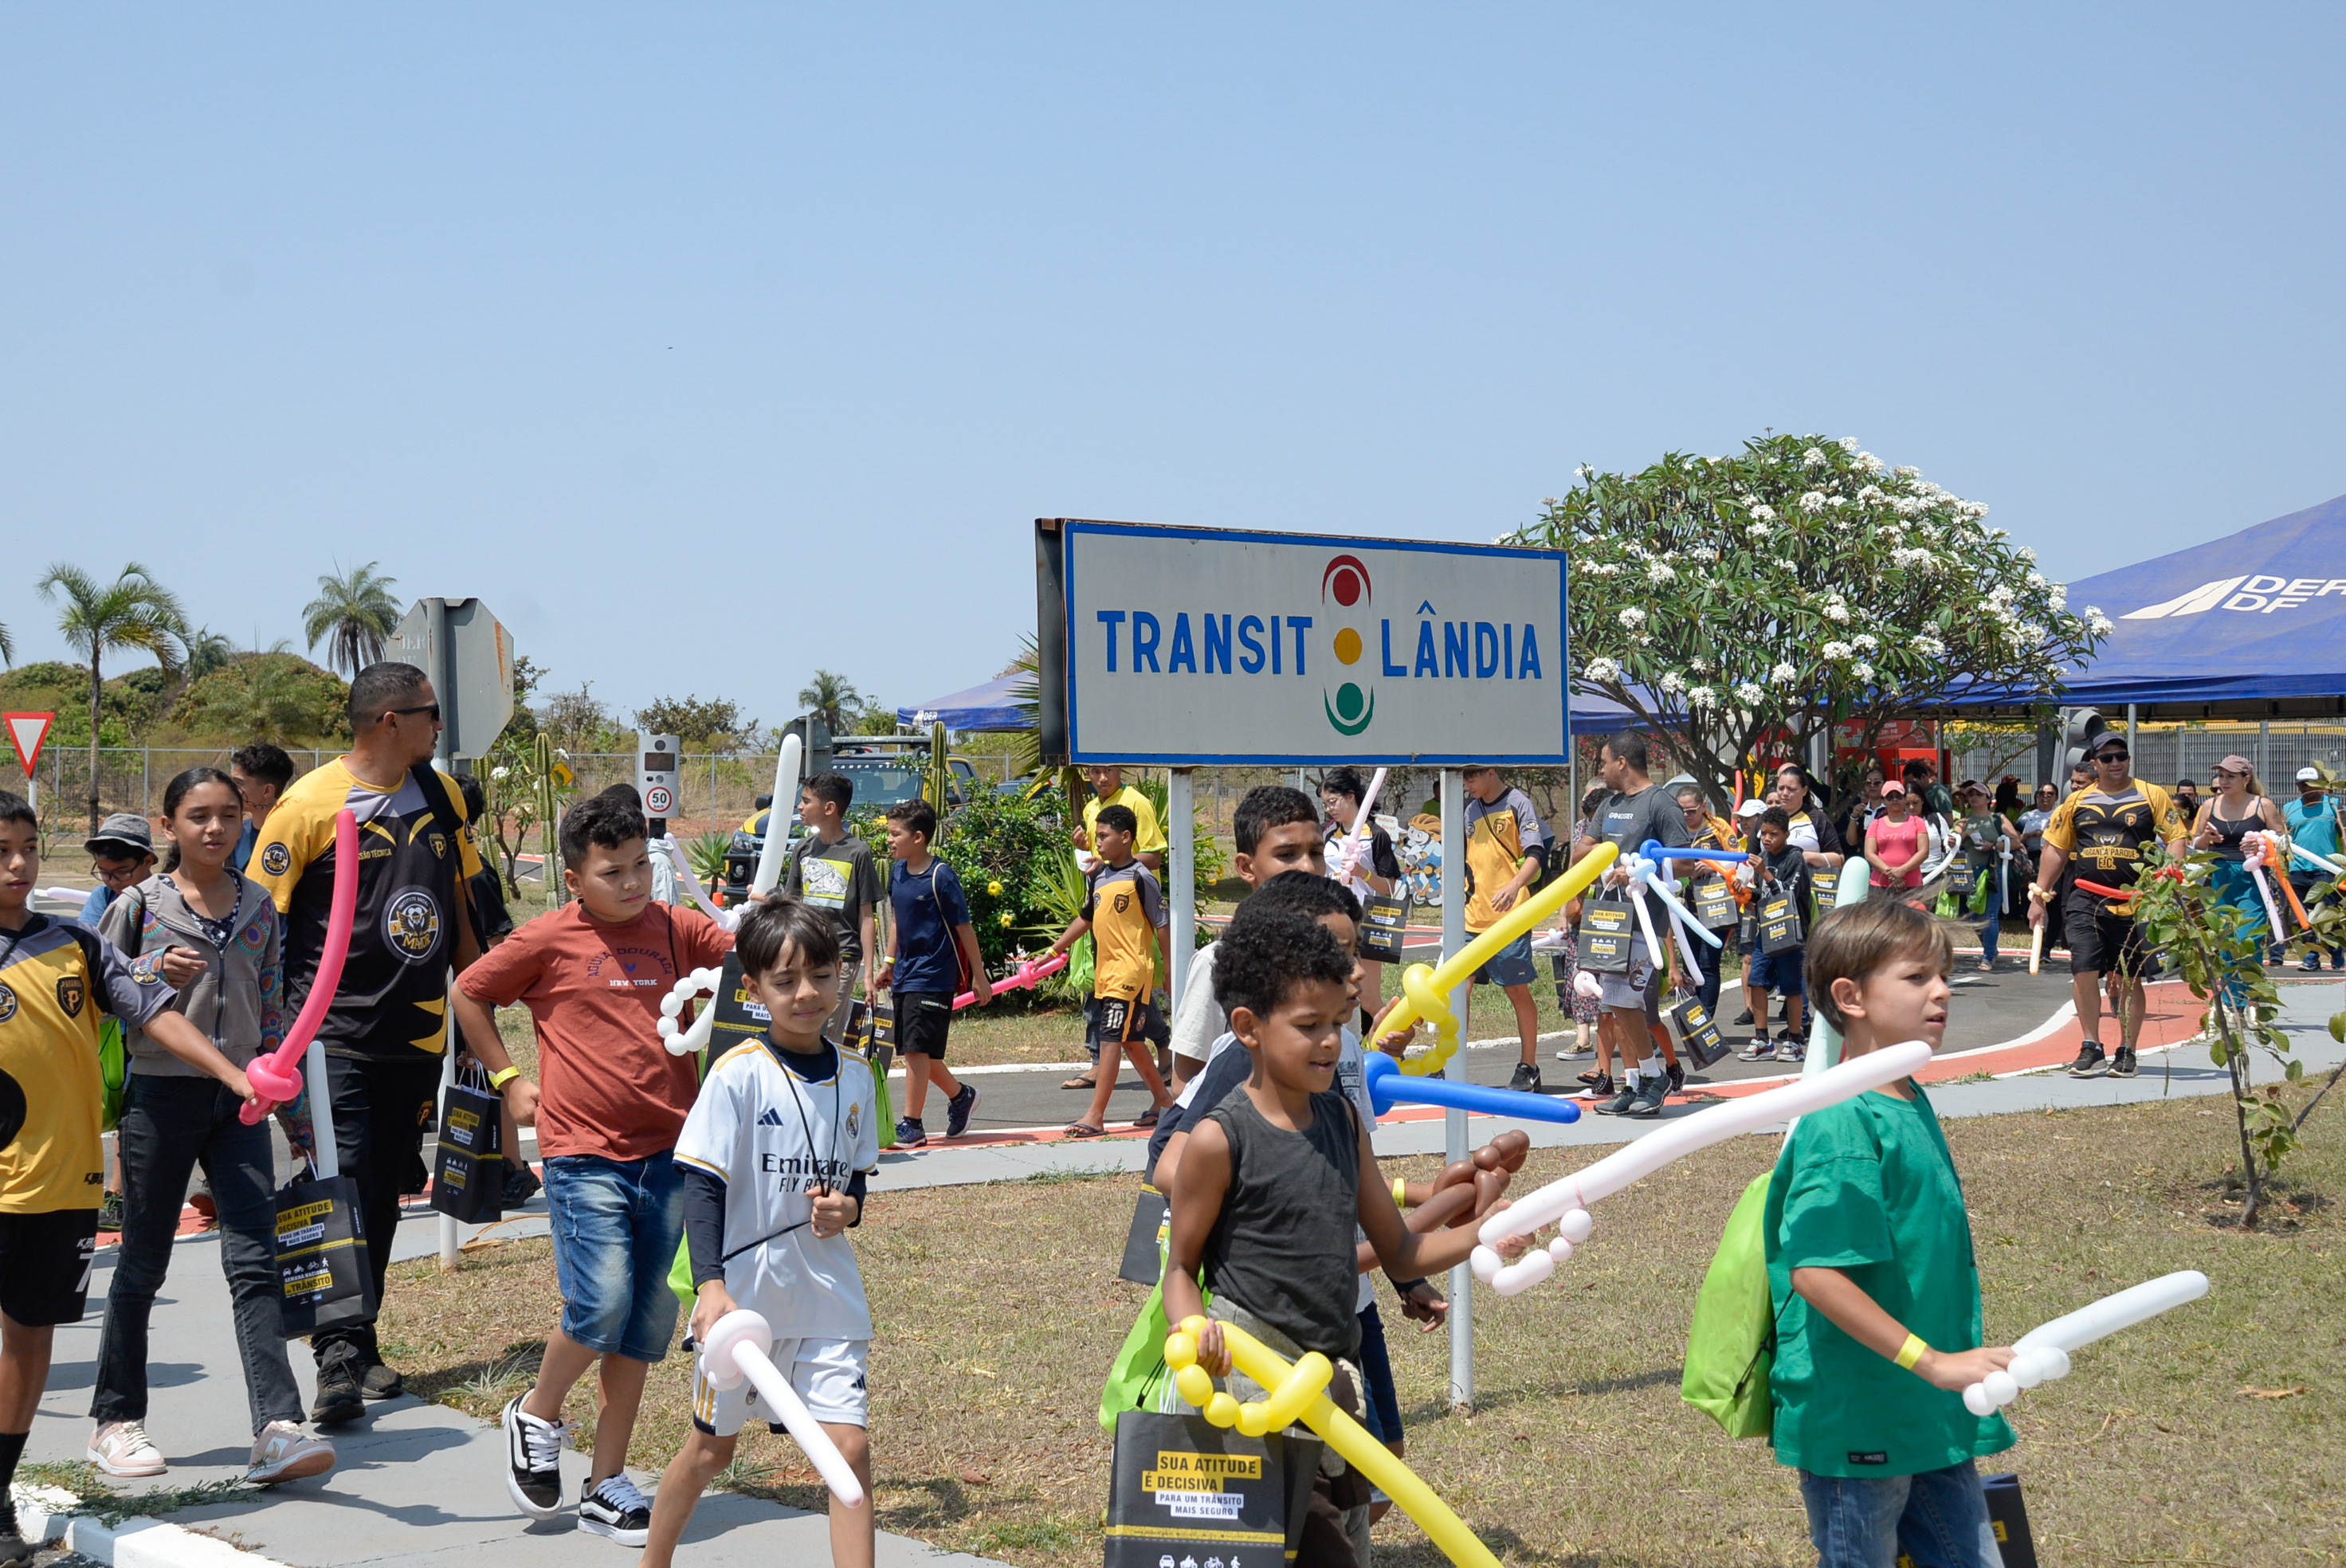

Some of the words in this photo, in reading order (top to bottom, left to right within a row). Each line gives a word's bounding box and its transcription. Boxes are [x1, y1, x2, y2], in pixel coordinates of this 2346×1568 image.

[2222, 593, 2309, 613] DF
[1096, 610, 1313, 676] TRANSIT
[1380, 599, 1542, 680] LÂNDIA
[652, 793, 667, 804] 50
[371, 849, 392, 858] TÉCNICA
[2111, 849, 2136, 858] PARQUE
[616, 947, 673, 975] DOURADA
[874, 1017, 892, 1026] TITUDE
[1107, 1009, 1124, 1029] 10
[762, 1153, 849, 1178] Emirate
[779, 1177, 800, 1193] FLY
[277, 1213, 292, 1224] SUA
[294, 1201, 330, 1218] ATITUDE
[278, 1218, 308, 1233] DECISIVA
[300, 1225, 324, 1235] TRÂNSITO
[300, 1232, 320, 1241] SEGURO
[284, 1273, 304, 1283] SEMANA
[304, 1268, 329, 1279] NACIONAL
[291, 1276, 331, 1292] TRÂNSITO
[1159, 1456, 1188, 1471] SUA
[1195, 1458, 1256, 1474] ATITUDE
[1145, 1472, 1152, 1488] É
[1158, 1476, 1218, 1491] DECISIVA
[1201, 1494, 1242, 1505] TRÂNSITO
[1199, 1507, 1234, 1516] SEGURO
